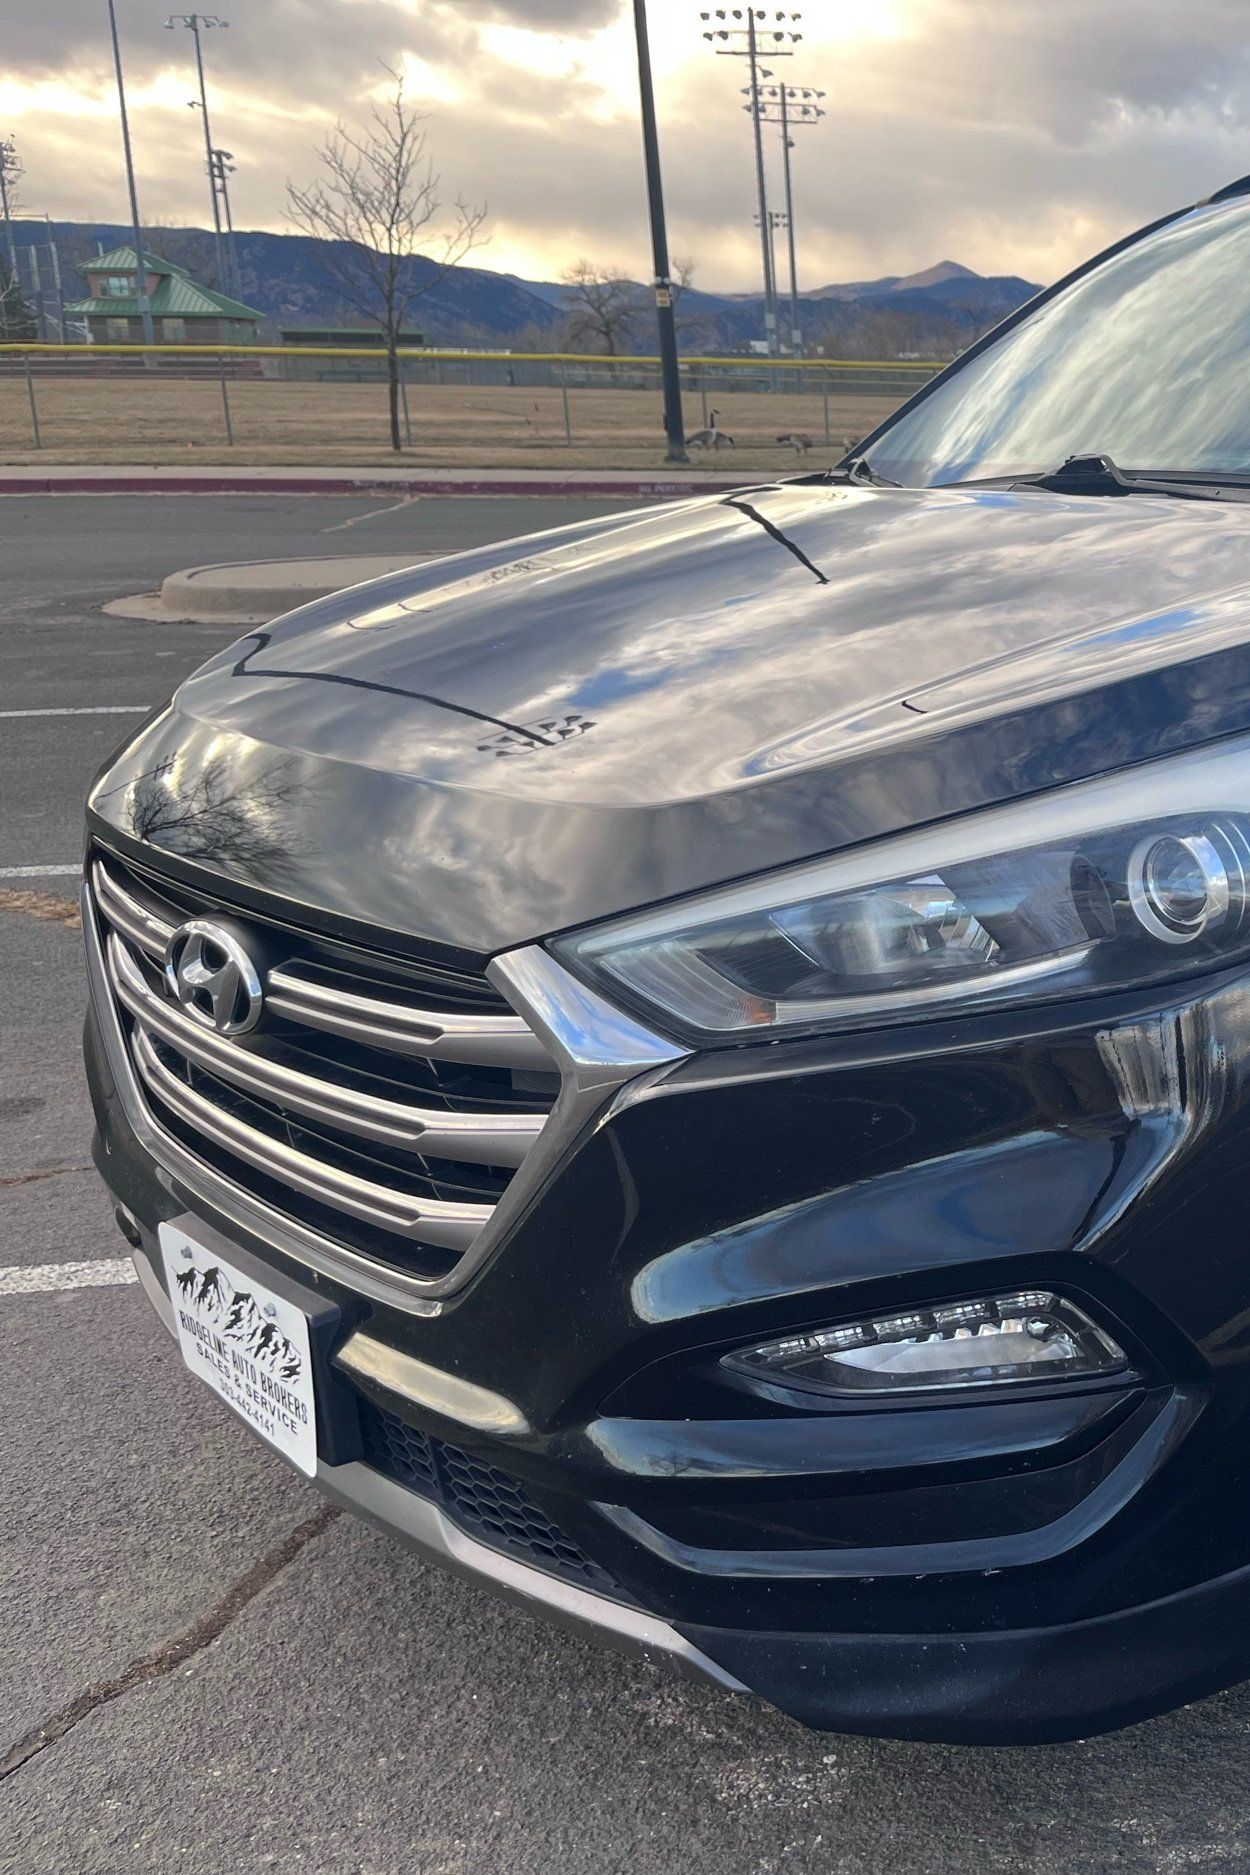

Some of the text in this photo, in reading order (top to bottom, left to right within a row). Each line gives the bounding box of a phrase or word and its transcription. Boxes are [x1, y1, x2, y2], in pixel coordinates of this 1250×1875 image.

[180, 1309, 308, 1425] RIDGELINE AUTO BROKERS
[196, 1344, 298, 1435] SALES & SERVICE
[220, 1378, 275, 1436] 303-442-4141
